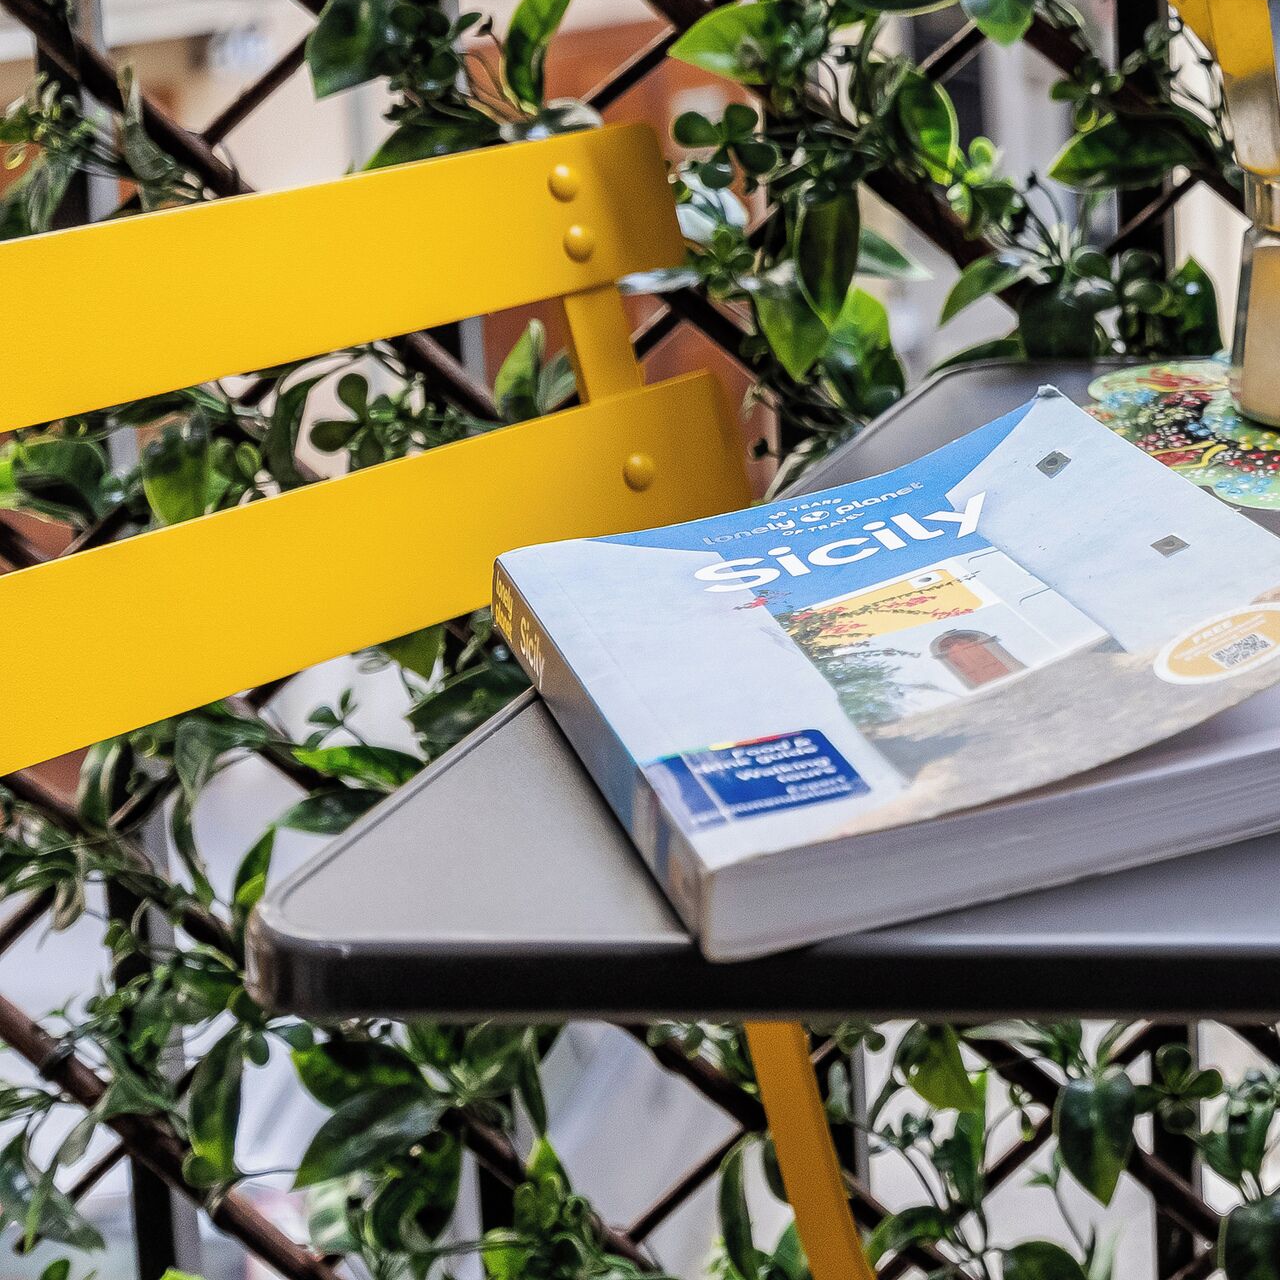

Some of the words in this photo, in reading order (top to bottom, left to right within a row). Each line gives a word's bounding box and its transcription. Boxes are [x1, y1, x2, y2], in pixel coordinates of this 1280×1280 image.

[790, 498, 843, 513] YEARS
[835, 481, 924, 516] planet
[782, 528, 803, 537] OF
[807, 511, 866, 533] TRAVEL
[694, 490, 986, 593] Sicily
[519, 616, 545, 690] Sicily
[731, 739, 791, 759] Food
[735, 756, 831, 782] Walking
